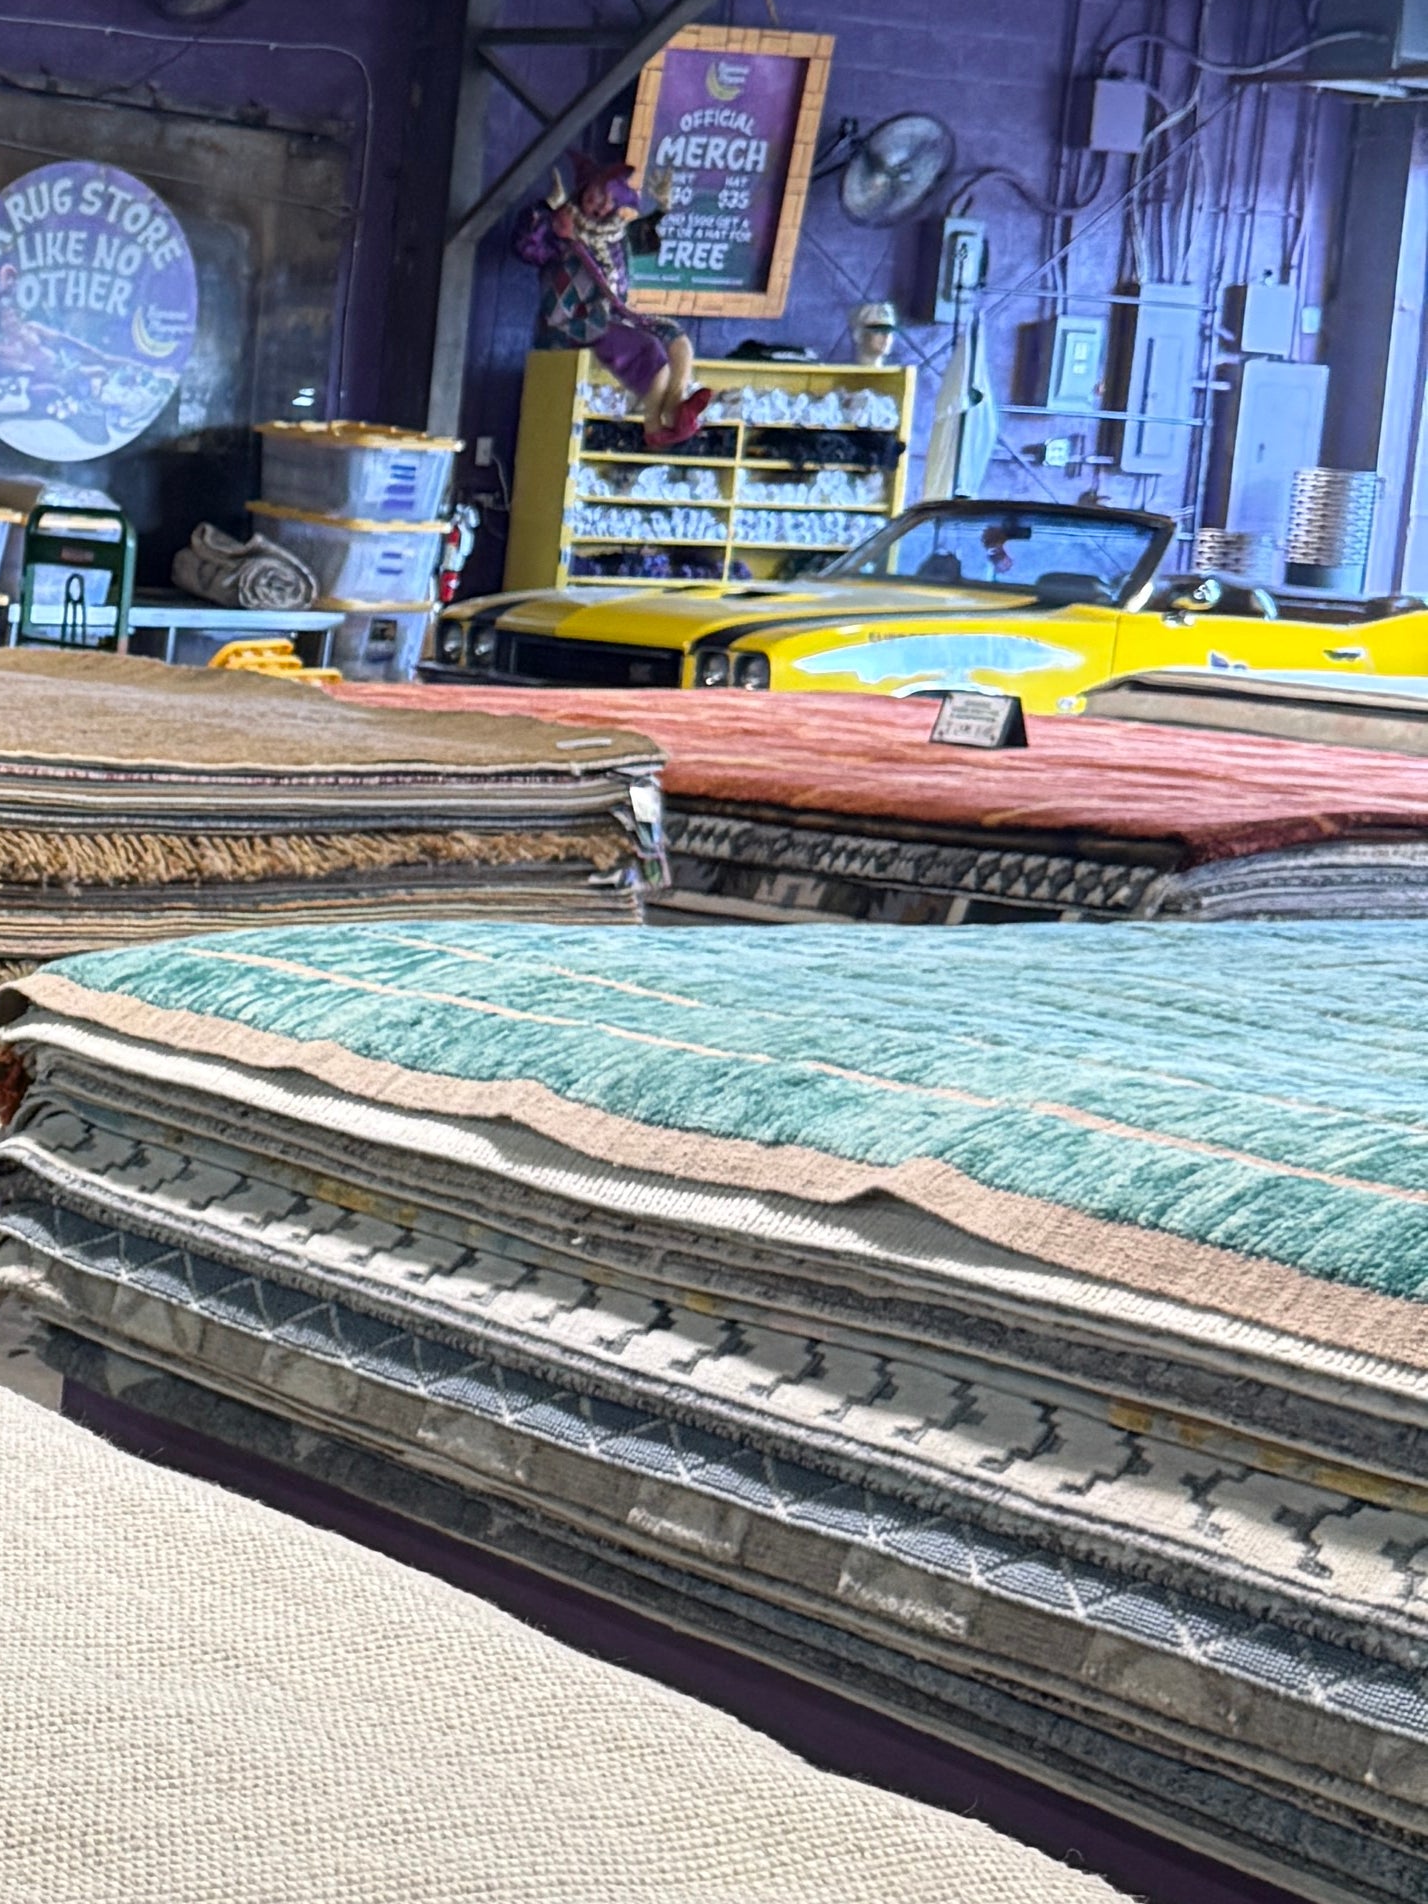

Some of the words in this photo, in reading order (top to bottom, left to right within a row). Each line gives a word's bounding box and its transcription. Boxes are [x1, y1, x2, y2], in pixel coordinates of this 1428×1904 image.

[679, 108, 755, 136] OFFICIAL
[655, 135, 768, 173] MERCH
[4, 177, 74, 233] RUG
[78, 180, 184, 271] STORE
[17, 230, 88, 271] LIKE
[92, 233, 142, 276] NO
[658, 239, 729, 271] FREE
[16, 270, 133, 317] OTHER
